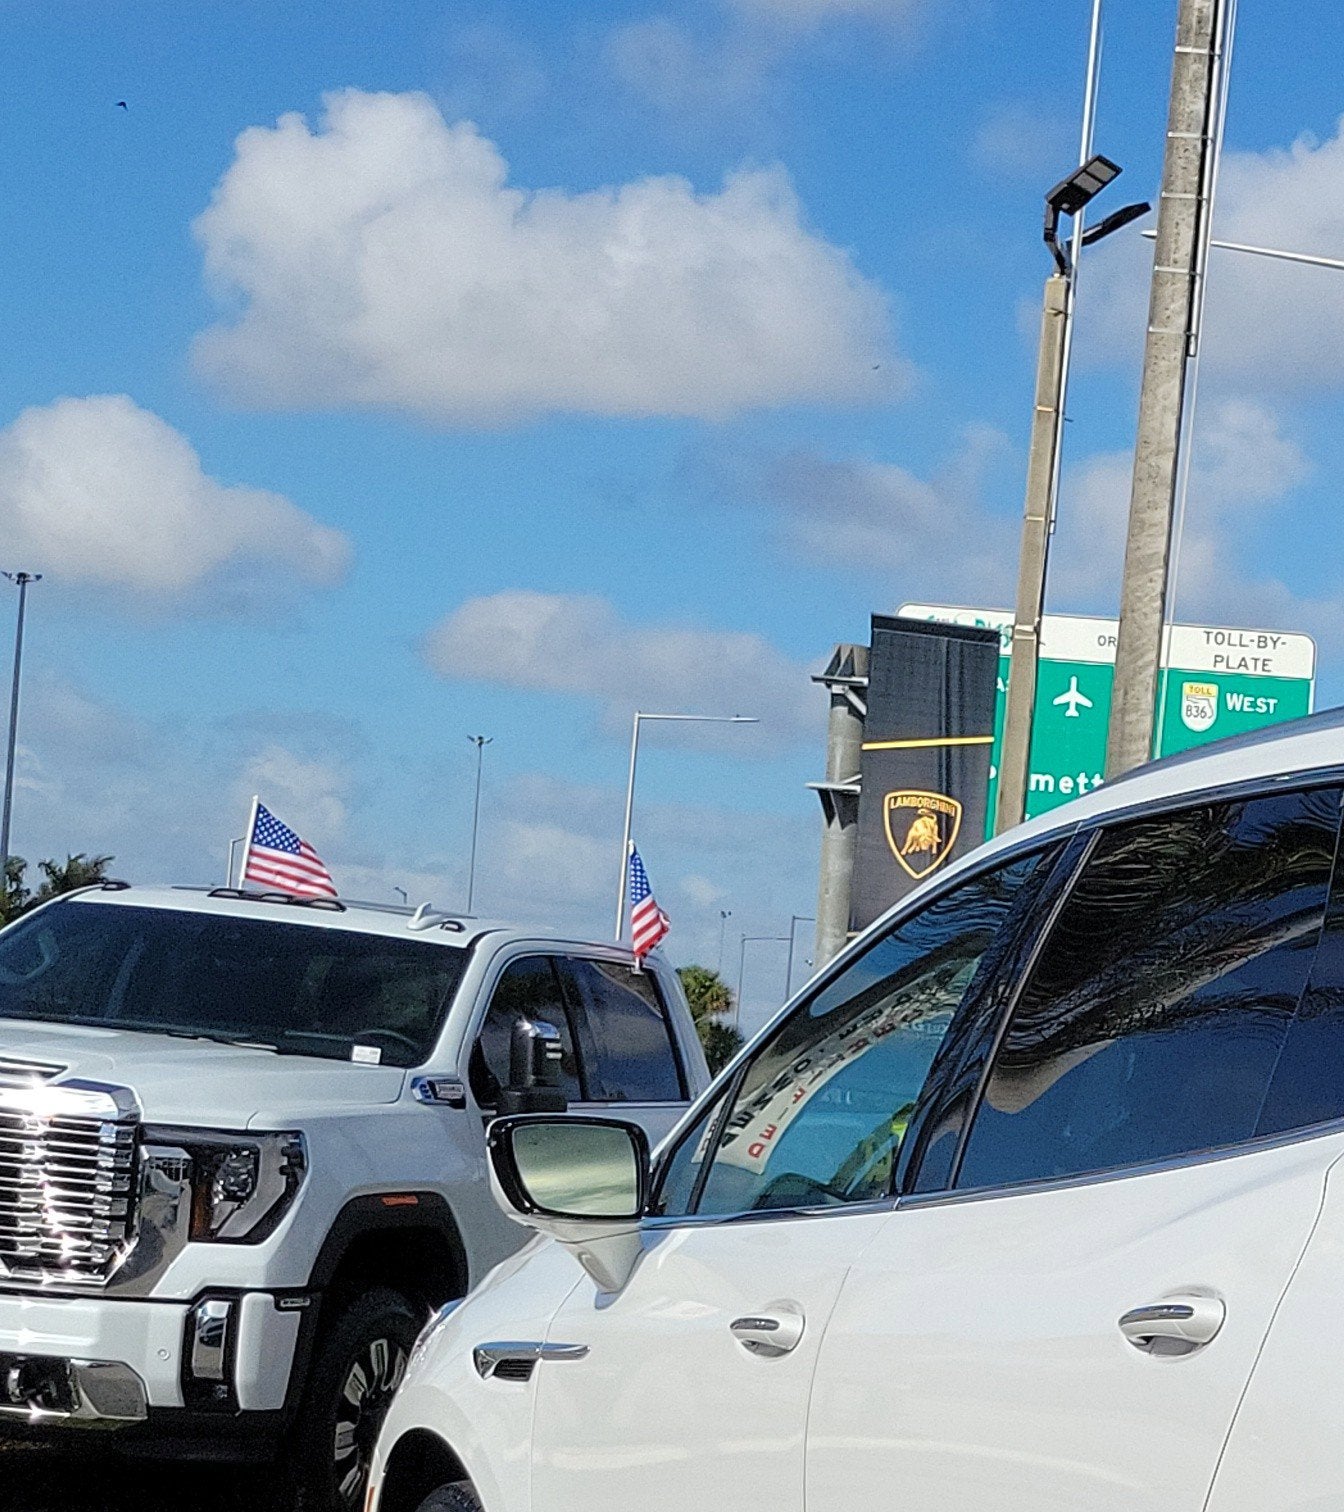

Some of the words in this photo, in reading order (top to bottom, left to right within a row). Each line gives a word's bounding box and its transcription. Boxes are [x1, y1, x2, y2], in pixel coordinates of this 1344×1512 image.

[1096, 634, 1117, 648] OR
[1203, 630, 1287, 650] TOLL-BY-
[1213, 654, 1273, 673] PLATE
[1188, 684, 1213, 696] TOLL
[1185, 703, 1208, 719] 836
[1225, 692, 1279, 715] WEST
